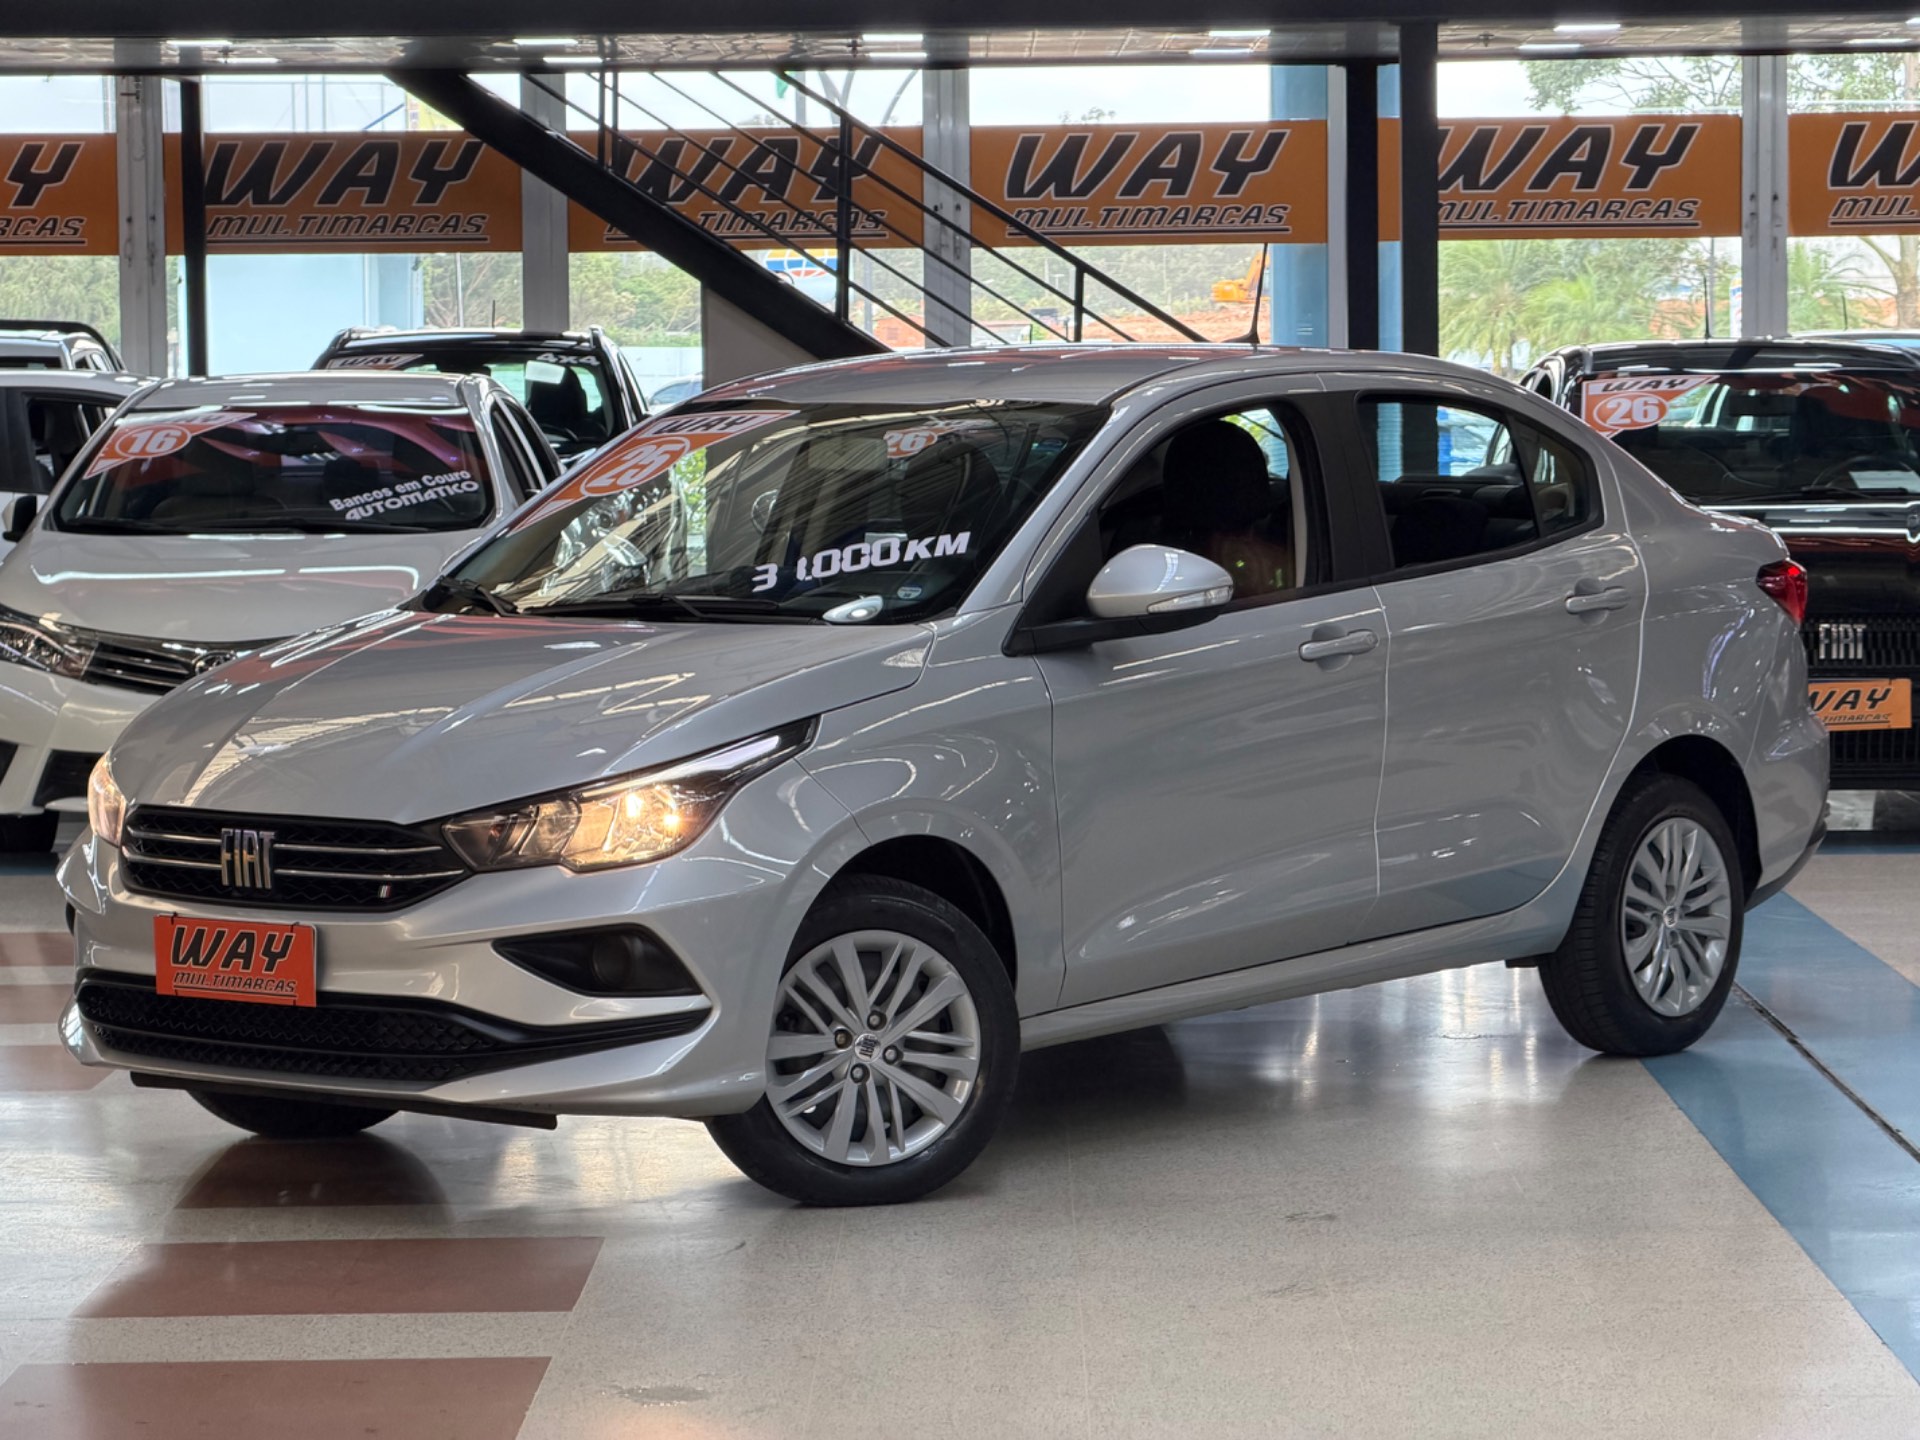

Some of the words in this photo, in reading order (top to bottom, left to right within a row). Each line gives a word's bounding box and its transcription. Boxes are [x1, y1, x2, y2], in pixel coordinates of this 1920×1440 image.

[205, 140, 485, 207] WAY
[1004, 129, 1291, 200] WAY
[1438, 124, 1702, 193] WAY
[207, 214, 489, 236] MULTIMARCAS
[1008, 204, 1291, 228] MULTIMARCAS
[1602, 379, 1688, 393] WAY
[653, 415, 757, 435] WAY
[1606, 396, 1660, 425] 26
[129, 430, 182, 454] 16
[587, 444, 682, 486] 25
[329, 486, 393, 512] Bancos
[395, 480, 423, 494] em
[422, 470, 472, 487] Couro
[1819, 624, 1867, 660] FIAT
[221, 827, 275, 889] FIAT
[171, 925, 295, 974] WAY
[173, 972, 297, 993] MULTIMARCAS
